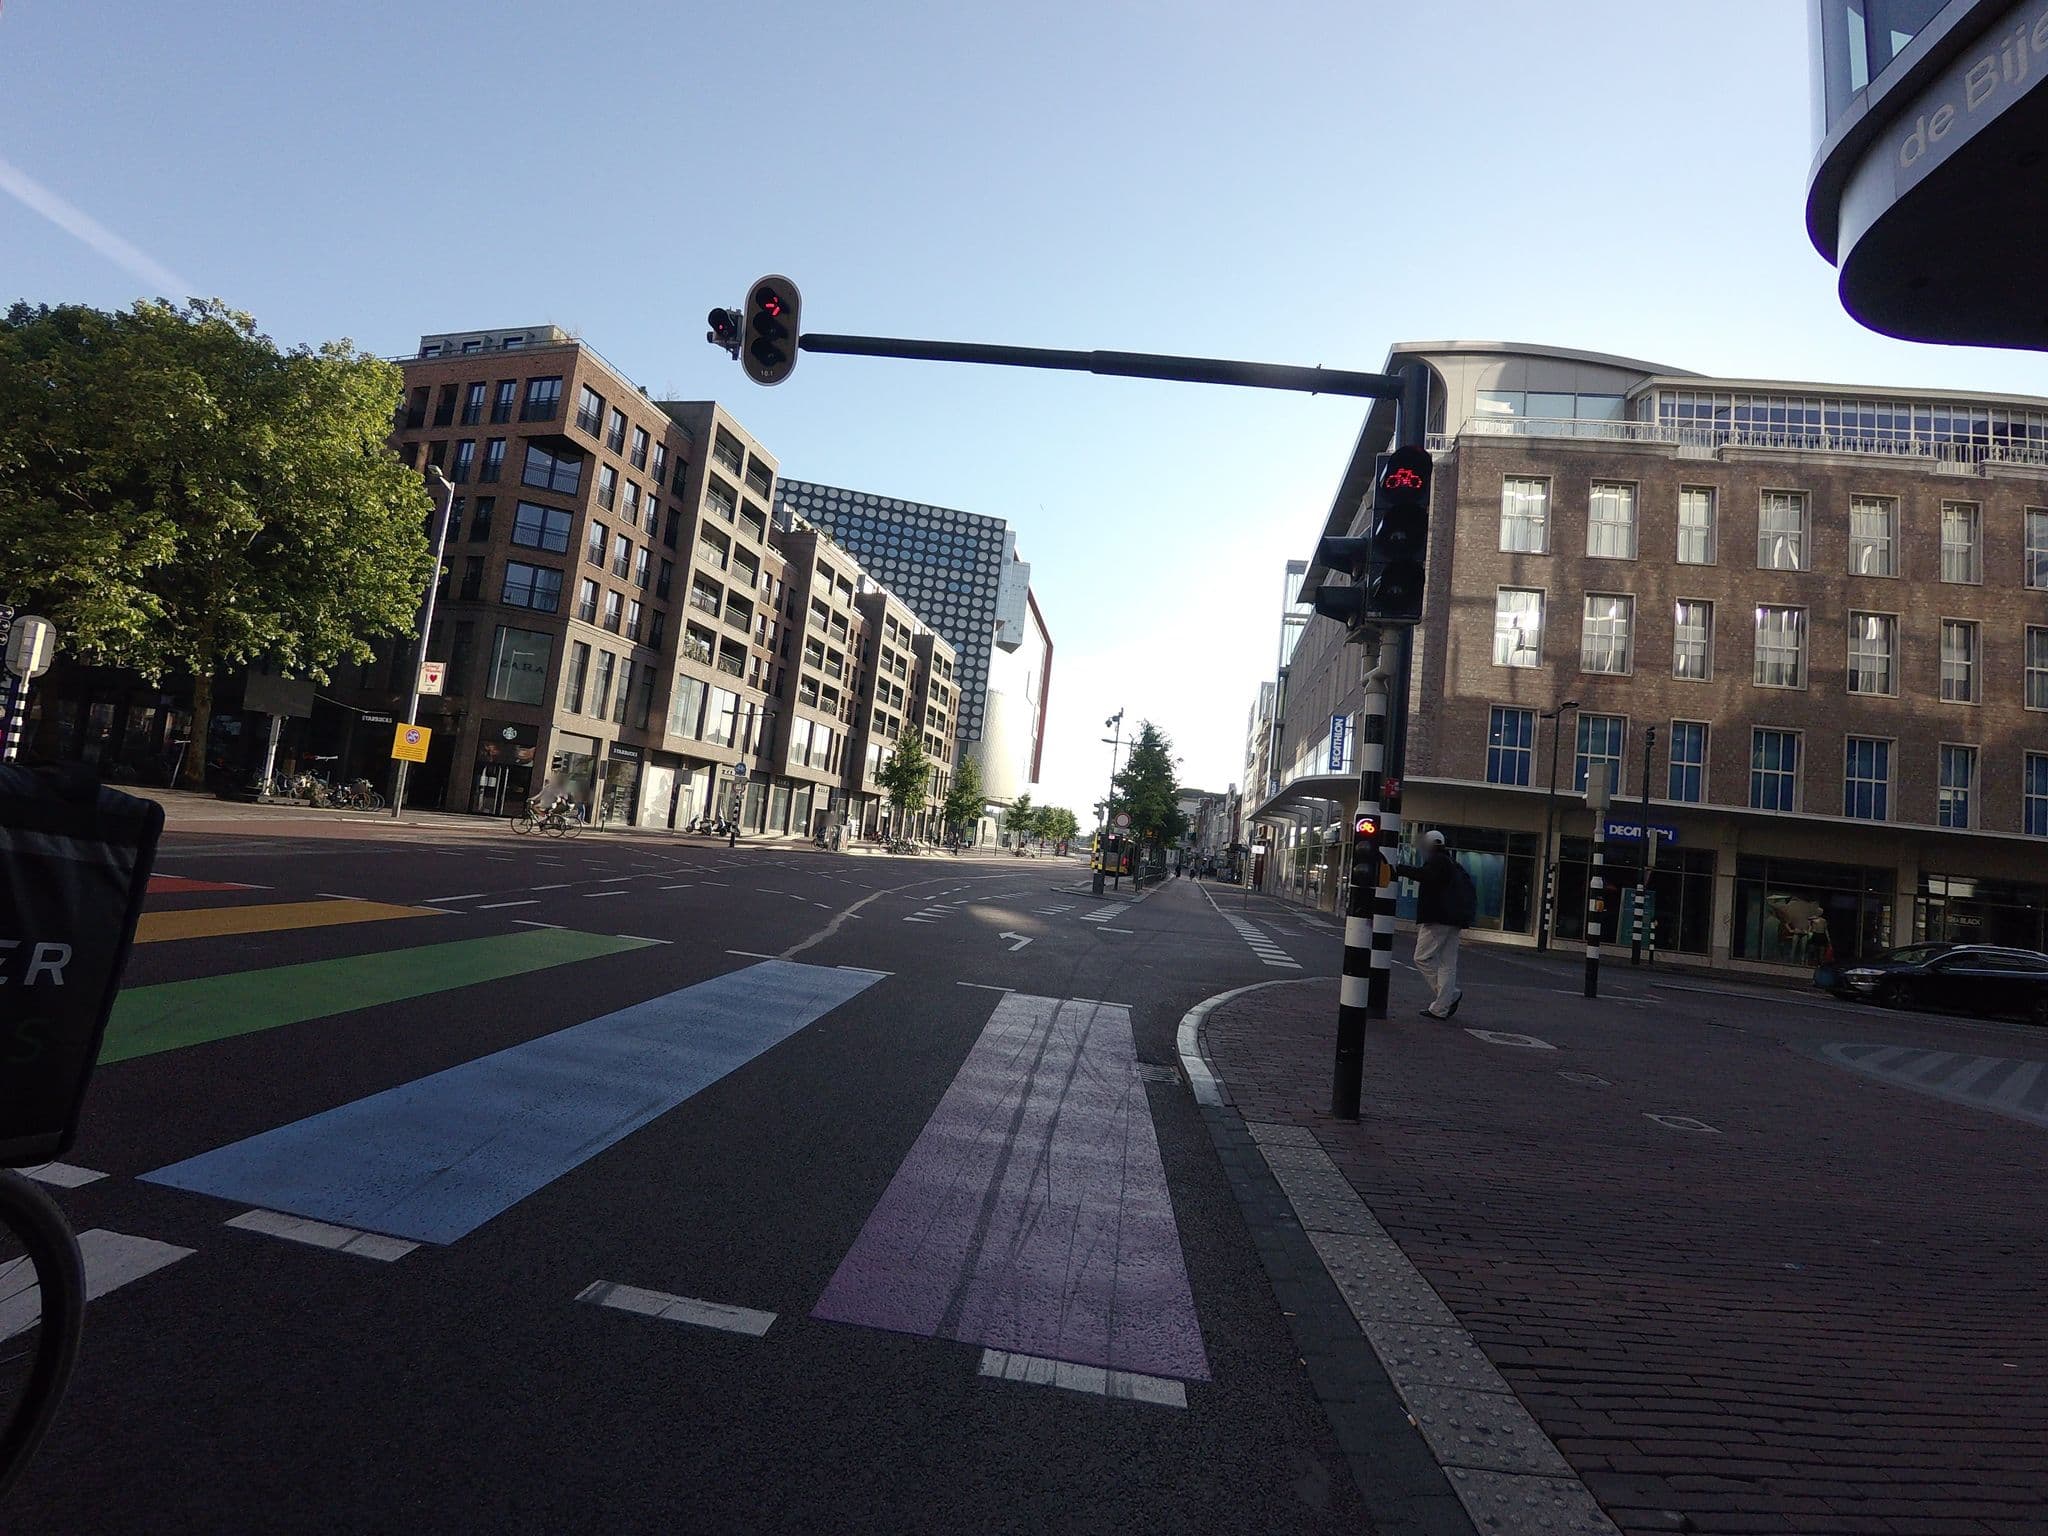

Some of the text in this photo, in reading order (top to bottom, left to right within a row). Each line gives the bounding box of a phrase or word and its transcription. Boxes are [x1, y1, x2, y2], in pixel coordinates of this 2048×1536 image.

[1900, 104, 1954, 168] de
[1331, 718, 1344, 767] DECATHLON
[1608, 824, 1673, 841] DECATN
